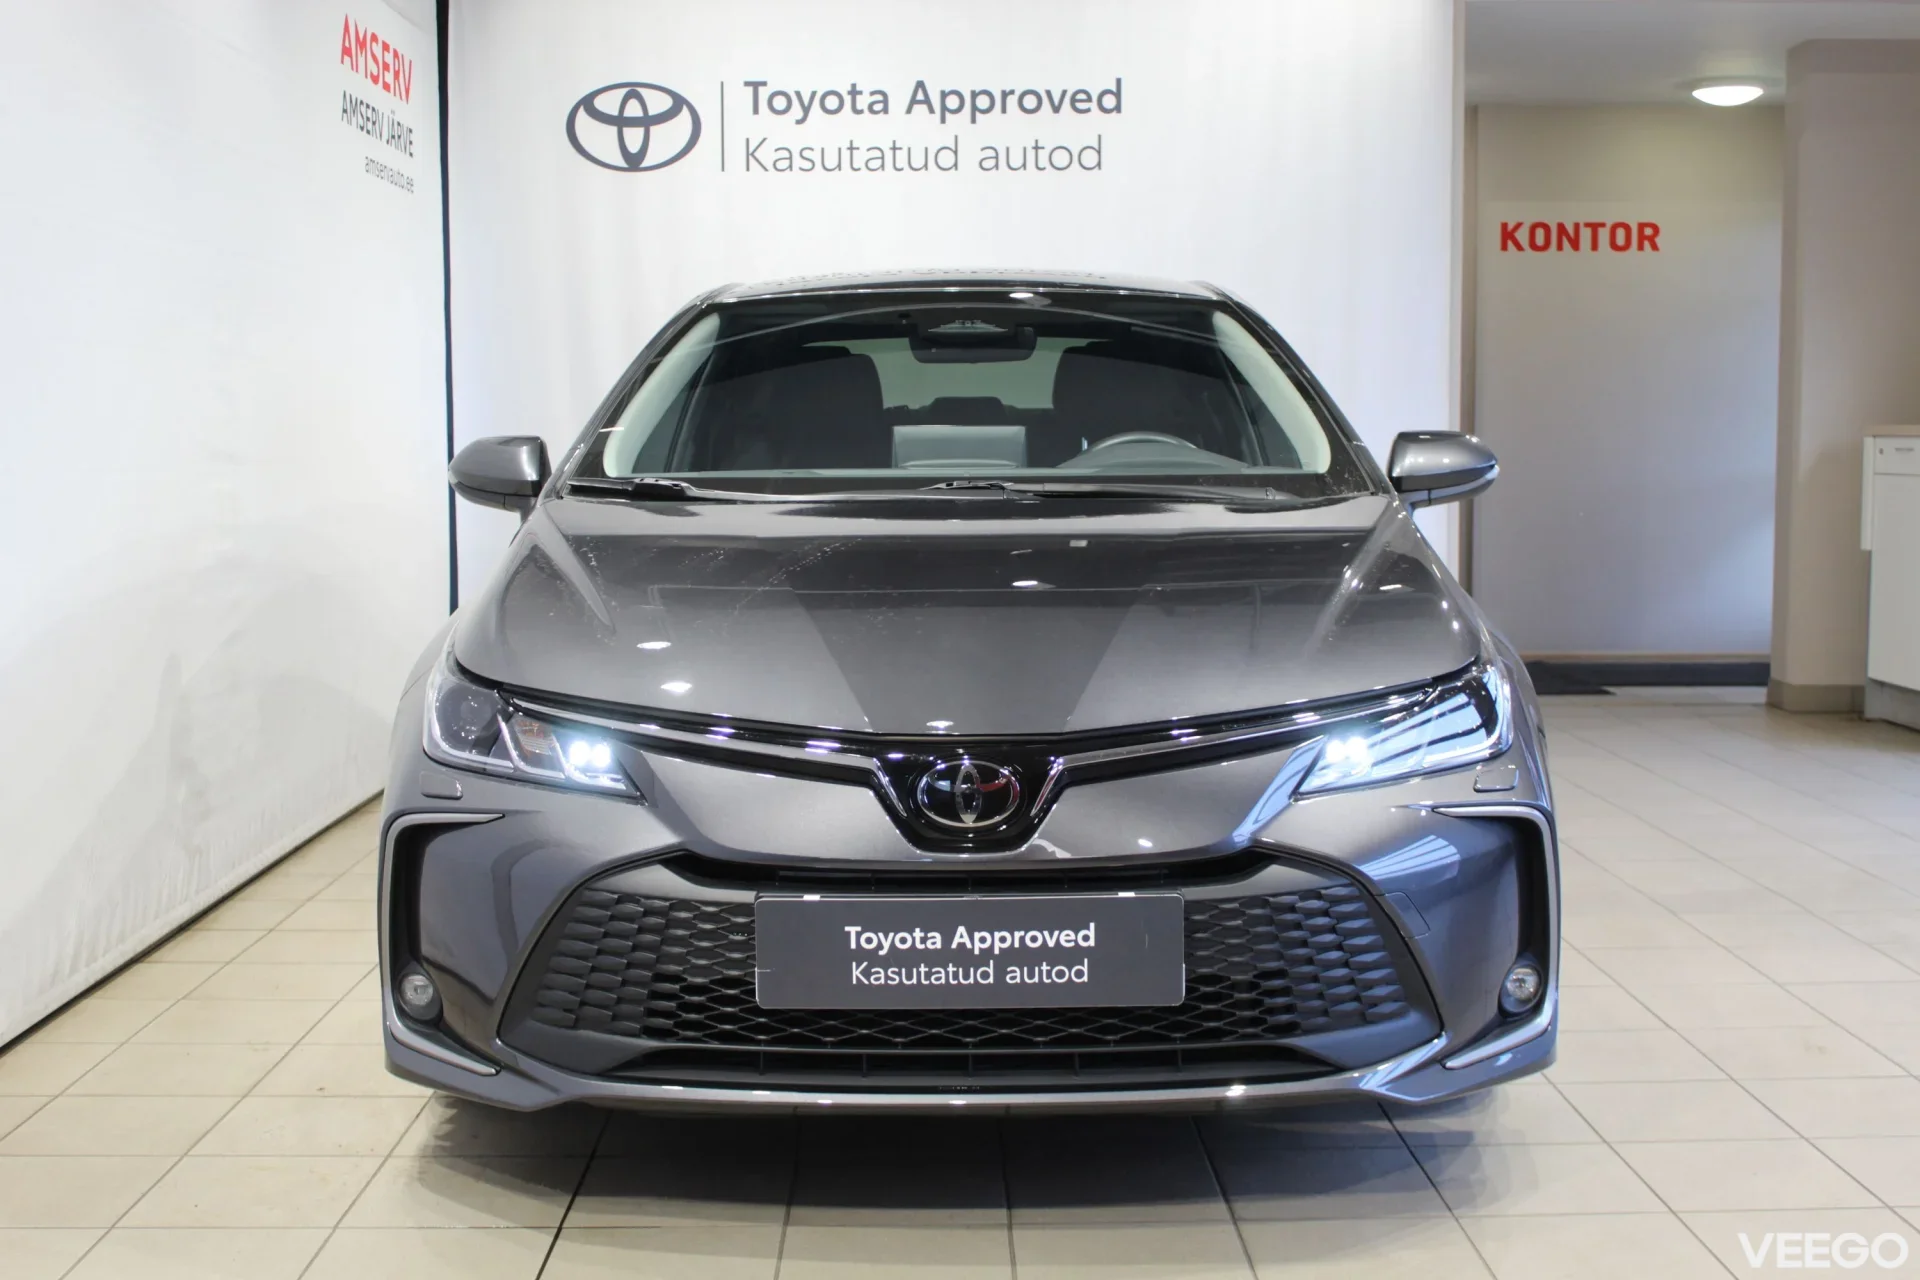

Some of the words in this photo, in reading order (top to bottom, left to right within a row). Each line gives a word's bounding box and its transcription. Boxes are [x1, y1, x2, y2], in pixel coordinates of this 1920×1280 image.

[340, 13, 412, 105] AMSERV
[743, 80, 891, 125] Toyota
[905, 77, 1123, 125] Approved
[341, 90, 384, 142] AMSERV
[386, 108, 414, 158] JÄRVE
[744, 136, 959, 173] Kasutatud
[978, 134, 1103, 172] autod
[364, 155, 414, 194] amservauto.ee
[1500, 221, 1661, 252] KONTOR
[844, 926, 942, 956] Toyota
[950, 923, 1096, 955] Approved
[851, 960, 995, 986] Kasutatud
[1004, 959, 1089, 984] autod
